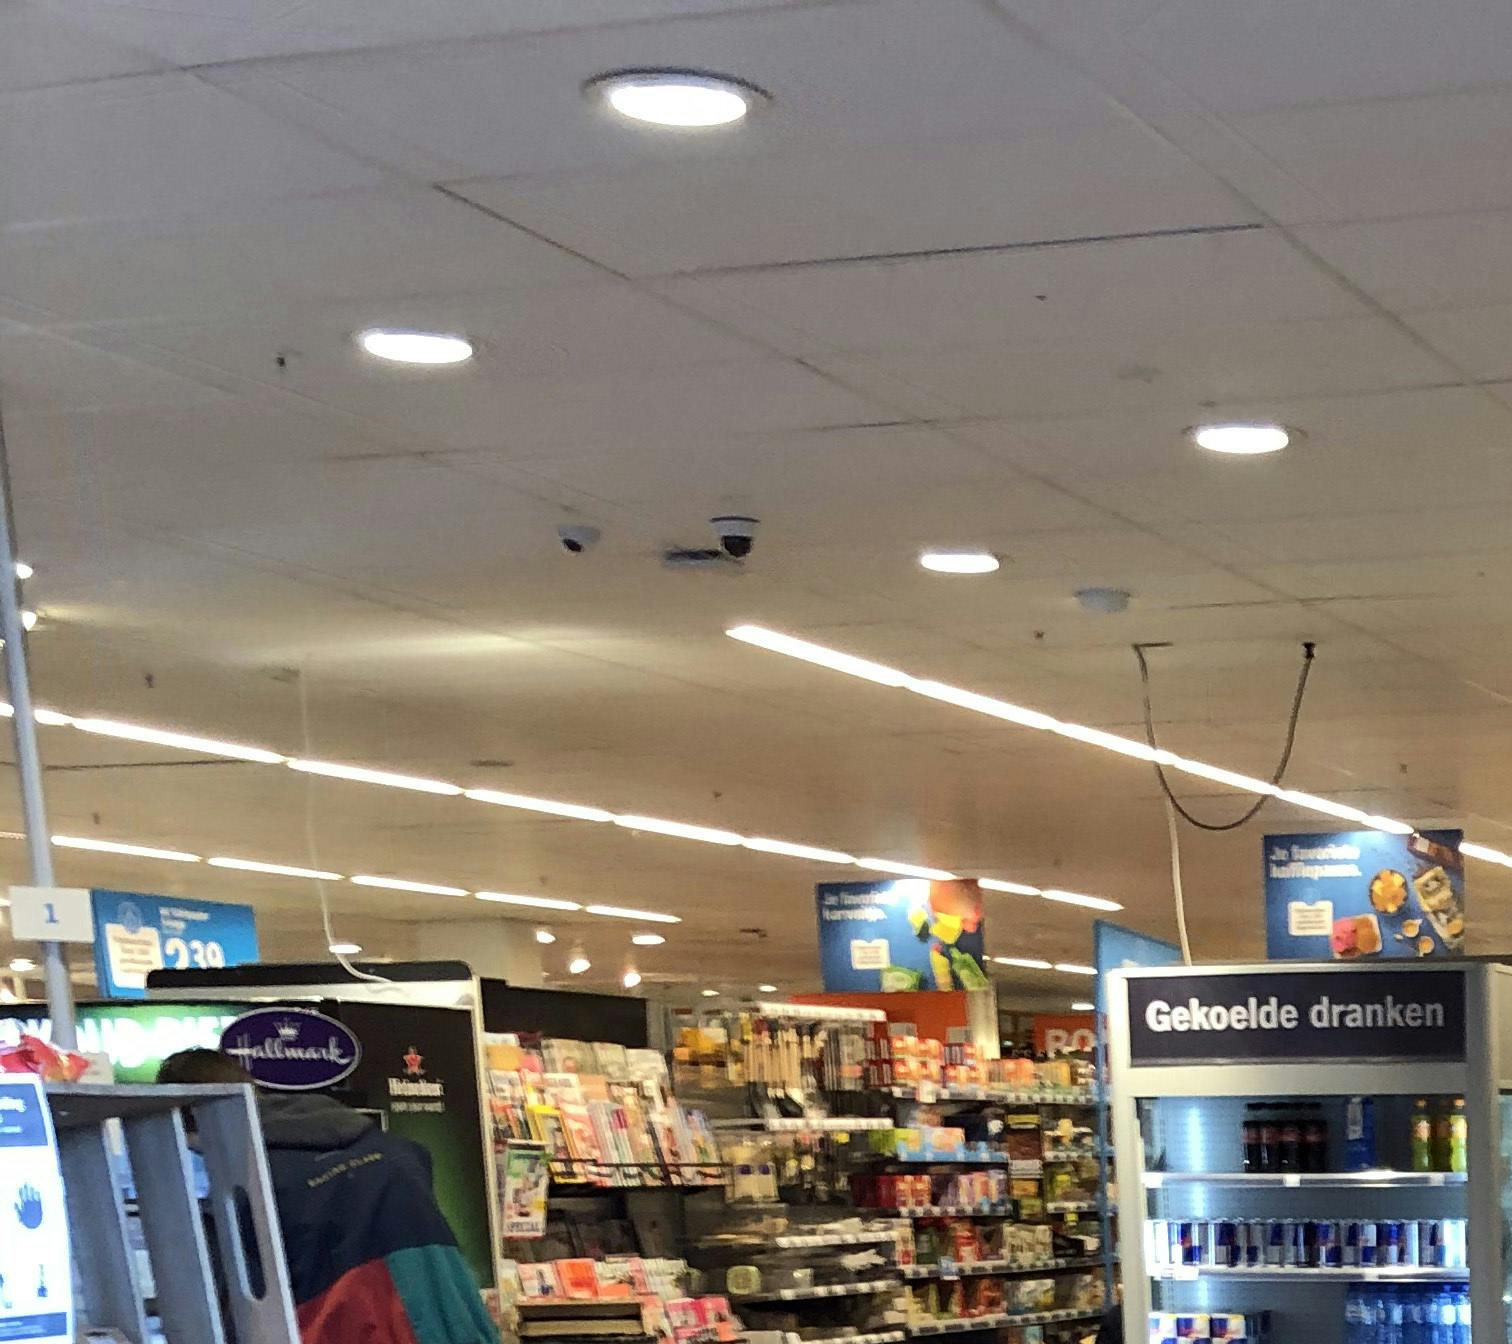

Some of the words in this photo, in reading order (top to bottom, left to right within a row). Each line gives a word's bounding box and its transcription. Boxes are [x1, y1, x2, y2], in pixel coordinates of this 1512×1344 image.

[44, 903, 60, 924] 1
[1145, 997, 1299, 1032] Gekoelde
[1309, 996, 1444, 1028] dranken
[226, 1031, 352, 1072] Hallmark
